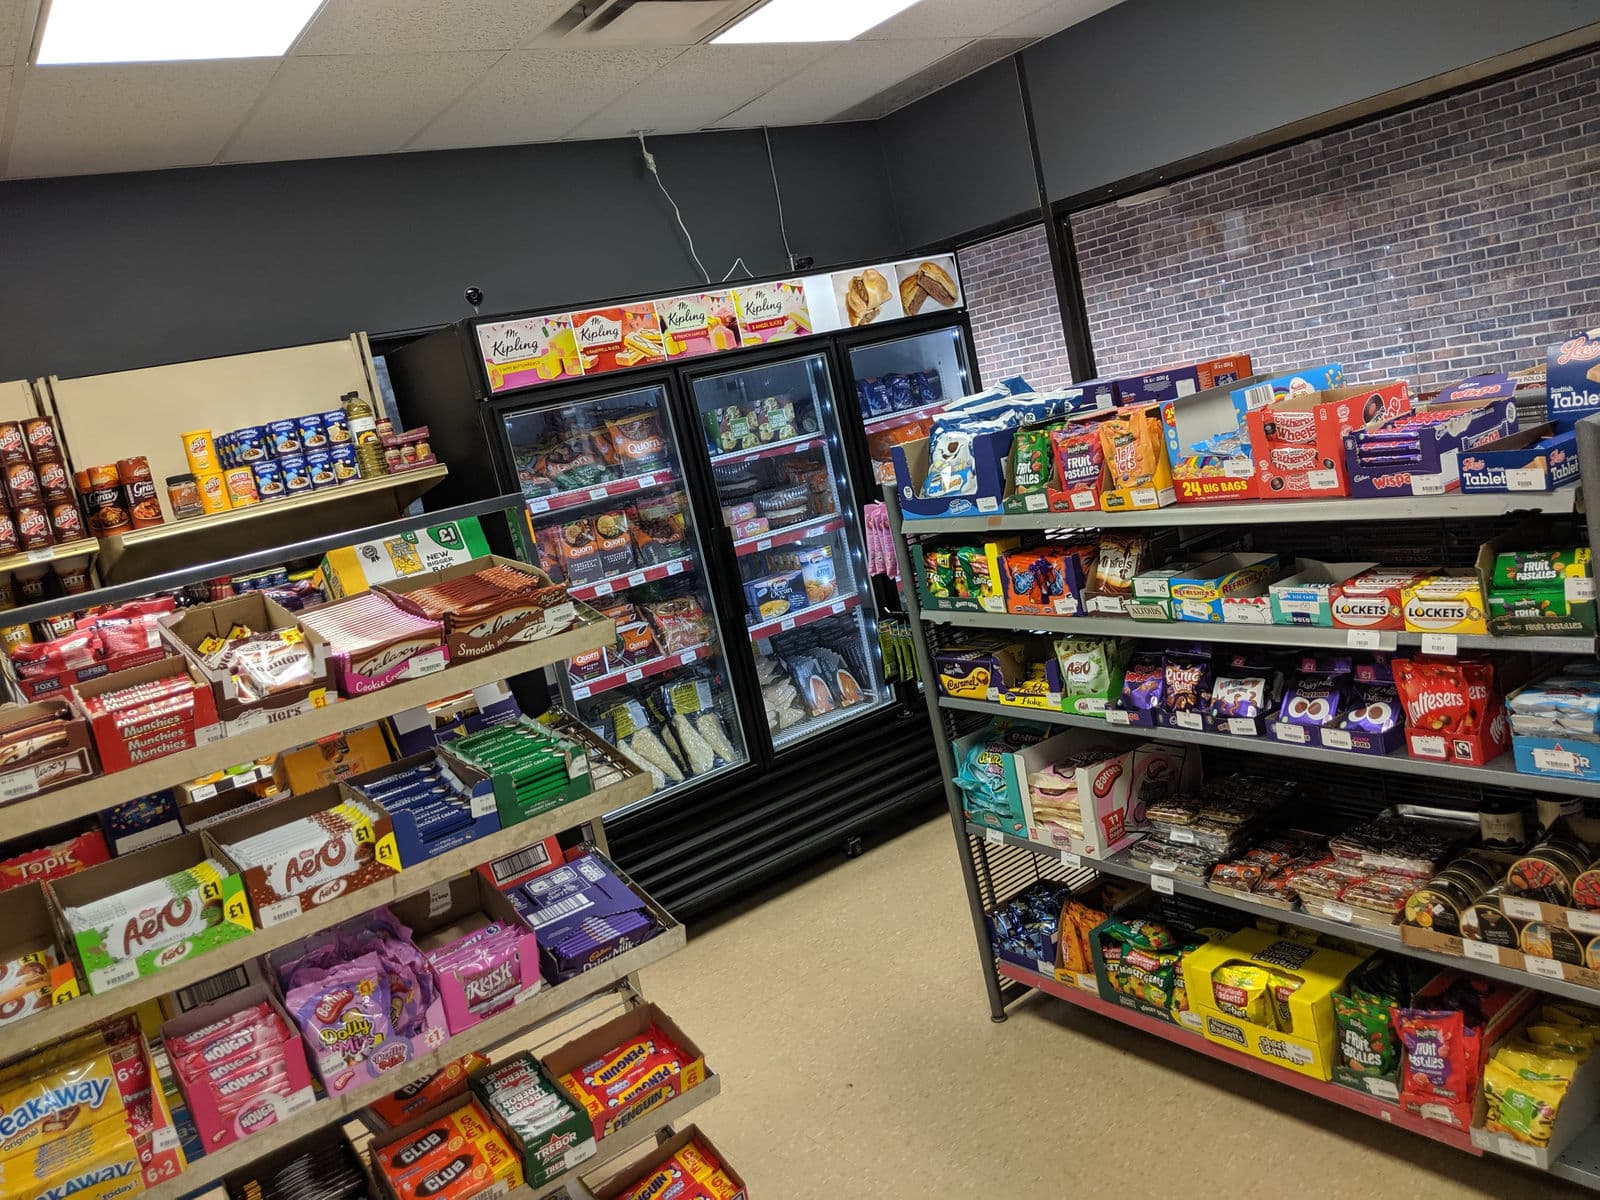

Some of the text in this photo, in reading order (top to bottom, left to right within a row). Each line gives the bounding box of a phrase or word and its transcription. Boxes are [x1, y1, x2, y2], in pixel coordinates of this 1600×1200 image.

[756, 290, 765, 299] Mr
[678, 302, 688, 310] Mr
[745, 298, 782, 315] Kipling
[668, 308, 705, 326] Kipling
[580, 325, 619, 341] Kipling
[493, 337, 538, 356] Kipling
[1451, 384, 1501, 400] Wispa
[1551, 386, 1573, 394] Scottish
[1551, 391, 1600, 409] Table
[29, 426, 52, 443] BISTO
[627, 439, 660, 454] Quorn
[1272, 448, 1315, 464] Catherine
[10, 471, 34, 488] BISTO
[41, 468, 64, 485] BISTO
[1463, 473, 1506, 486] Tablet
[1551, 462, 1579, 480] Tablet
[134, 481, 154, 497] Gra
[1183, 480, 1248, 496] 24 BIG BAGS
[1373, 472, 1411, 489] Wispa
[21, 515, 44, 532] BISTO
[55, 509, 77, 527] BISTO
[439, 527, 456, 543] £1
[604, 537, 625, 549] Quorn
[427, 550, 449, 561] NEW
[570, 545, 593, 557] Quorn
[427, 557, 454, 567] BIGGER
[1222, 568, 1270, 594] REFRESHERS
[1516, 570, 1557, 581] Pastilles
[1132, 607, 1162, 616] ALTOIDS
[1335, 604, 1387, 616] LOCKETS
[1408, 607, 1465, 619] LOCKETS
[52, 619, 75, 633] POT
[458, 641, 495, 656] Smooth
[629, 639, 648, 650] Quorn
[358, 647, 421, 677] Galaxy
[576, 651, 599, 663] Quorn
[947, 675, 979, 691] Caramel
[1165, 668, 1200, 683] Picnic
[1362, 671, 1372, 679] £1
[356, 677, 386, 693] Cookie
[1175, 681, 1193, 690] Bites
[314, 697, 327, 709] £1
[1408, 691, 1464, 727] Maltesers
[124, 715, 180, 737] Munchies
[128, 728, 184, 751] Munchies
[130, 740, 187, 761] Munchies
[1095, 765, 1122, 791] Barratt
[355, 825, 370, 841] £1
[379, 843, 392, 859] £1
[17, 850, 76, 878] Topic
[286, 839, 347, 891] Aero
[203, 881, 221, 899] £1
[319, 880, 342, 900] Aero
[229, 901, 244, 918] £1
[124, 896, 192, 956] Aero
[161, 944, 186, 964] Aero
[613, 942, 635, 958] Milk
[466, 961, 512, 999] RKISH
[1144, 974, 1164, 988] GEMS
[56, 990, 72, 1005] £1
[186, 1019, 231, 1043] NOUGAT
[320, 1019, 371, 1045] Dolly
[204, 1032, 253, 1062] NOUGAT
[1415, 1042, 1436, 1057] FRUit
[117, 1062, 145, 1083] 6+2
[209, 1053, 258, 1080] NOUGAT
[599, 1046, 646, 1084] PENGUIN
[220, 1066, 270, 1095] NOUGAT
[493, 1066, 534, 1089] TREBOR
[508, 1090, 549, 1117] TREBOR
[613, 1089, 663, 1132] PENGUIN
[240, 1104, 275, 1128] NOUGA
[4, 1128, 39, 1151] original
[534, 1132, 577, 1161] TREBOR
[400, 1133, 441, 1164] CLUB
[146, 1160, 176, 1183] 6+2
[424, 1159, 465, 1193] CLUB
[545, 1159, 566, 1176] TREB
